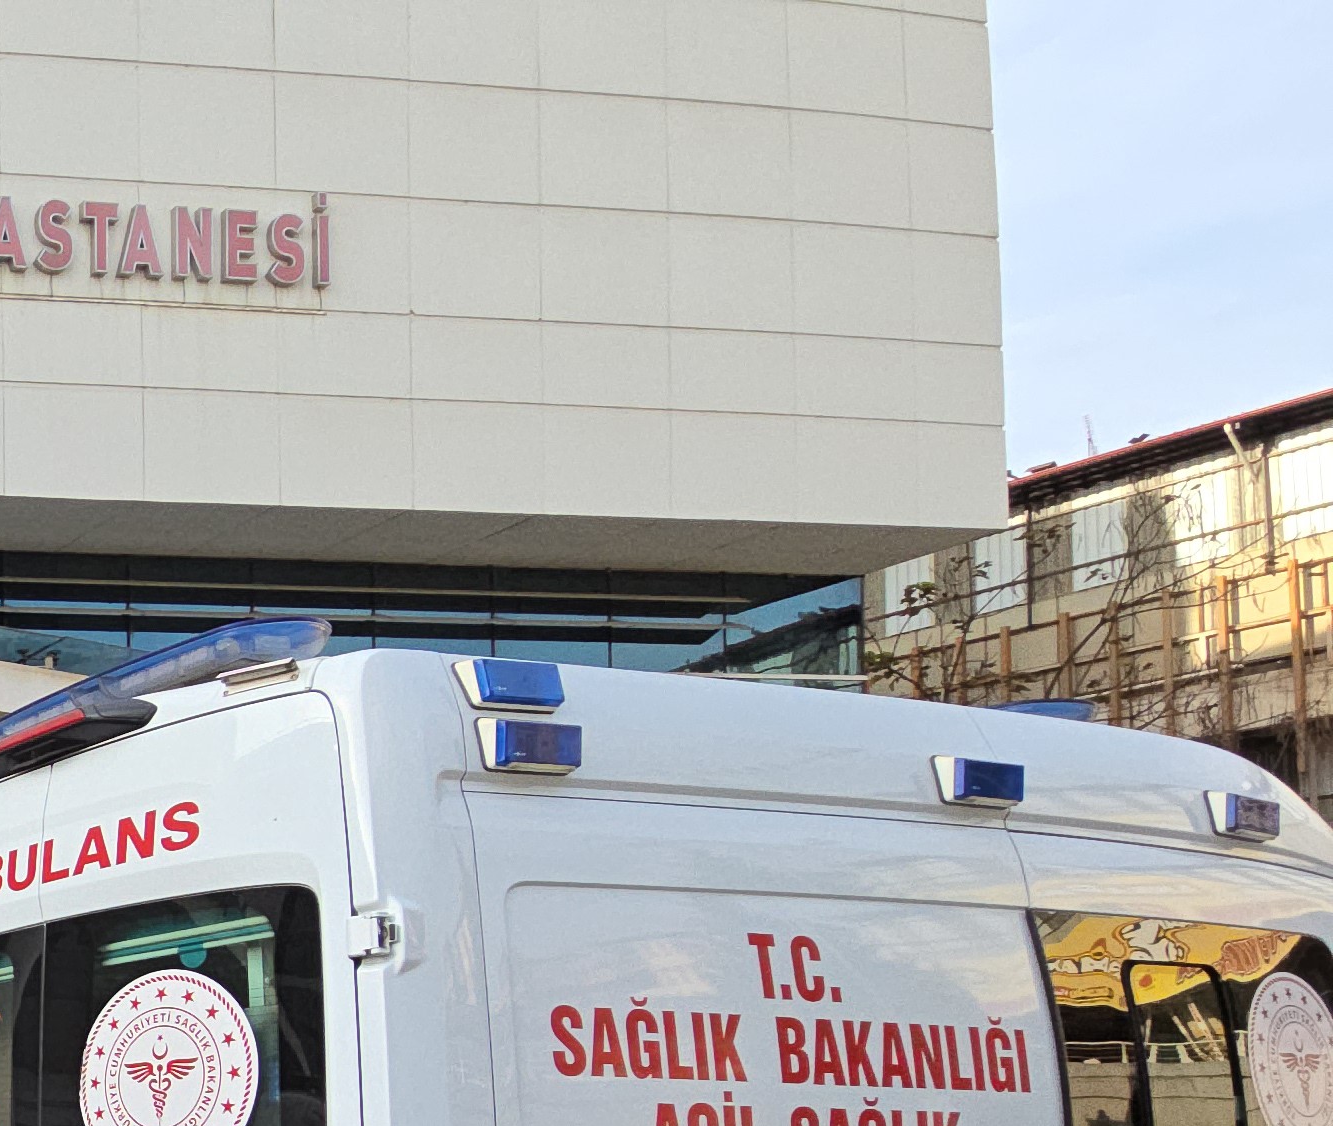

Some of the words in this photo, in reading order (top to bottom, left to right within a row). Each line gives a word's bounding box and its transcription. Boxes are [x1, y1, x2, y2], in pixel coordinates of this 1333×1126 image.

[747, 933, 842, 1003] T.C.
[108, 1011, 172, 1077] CUMHURİYETİ
[174, 1013, 214, 1051] SAĞLIK
[550, 995, 748, 1082] SAĞLIK
[778, 1015, 1032, 1094] BAKANLIĞI
